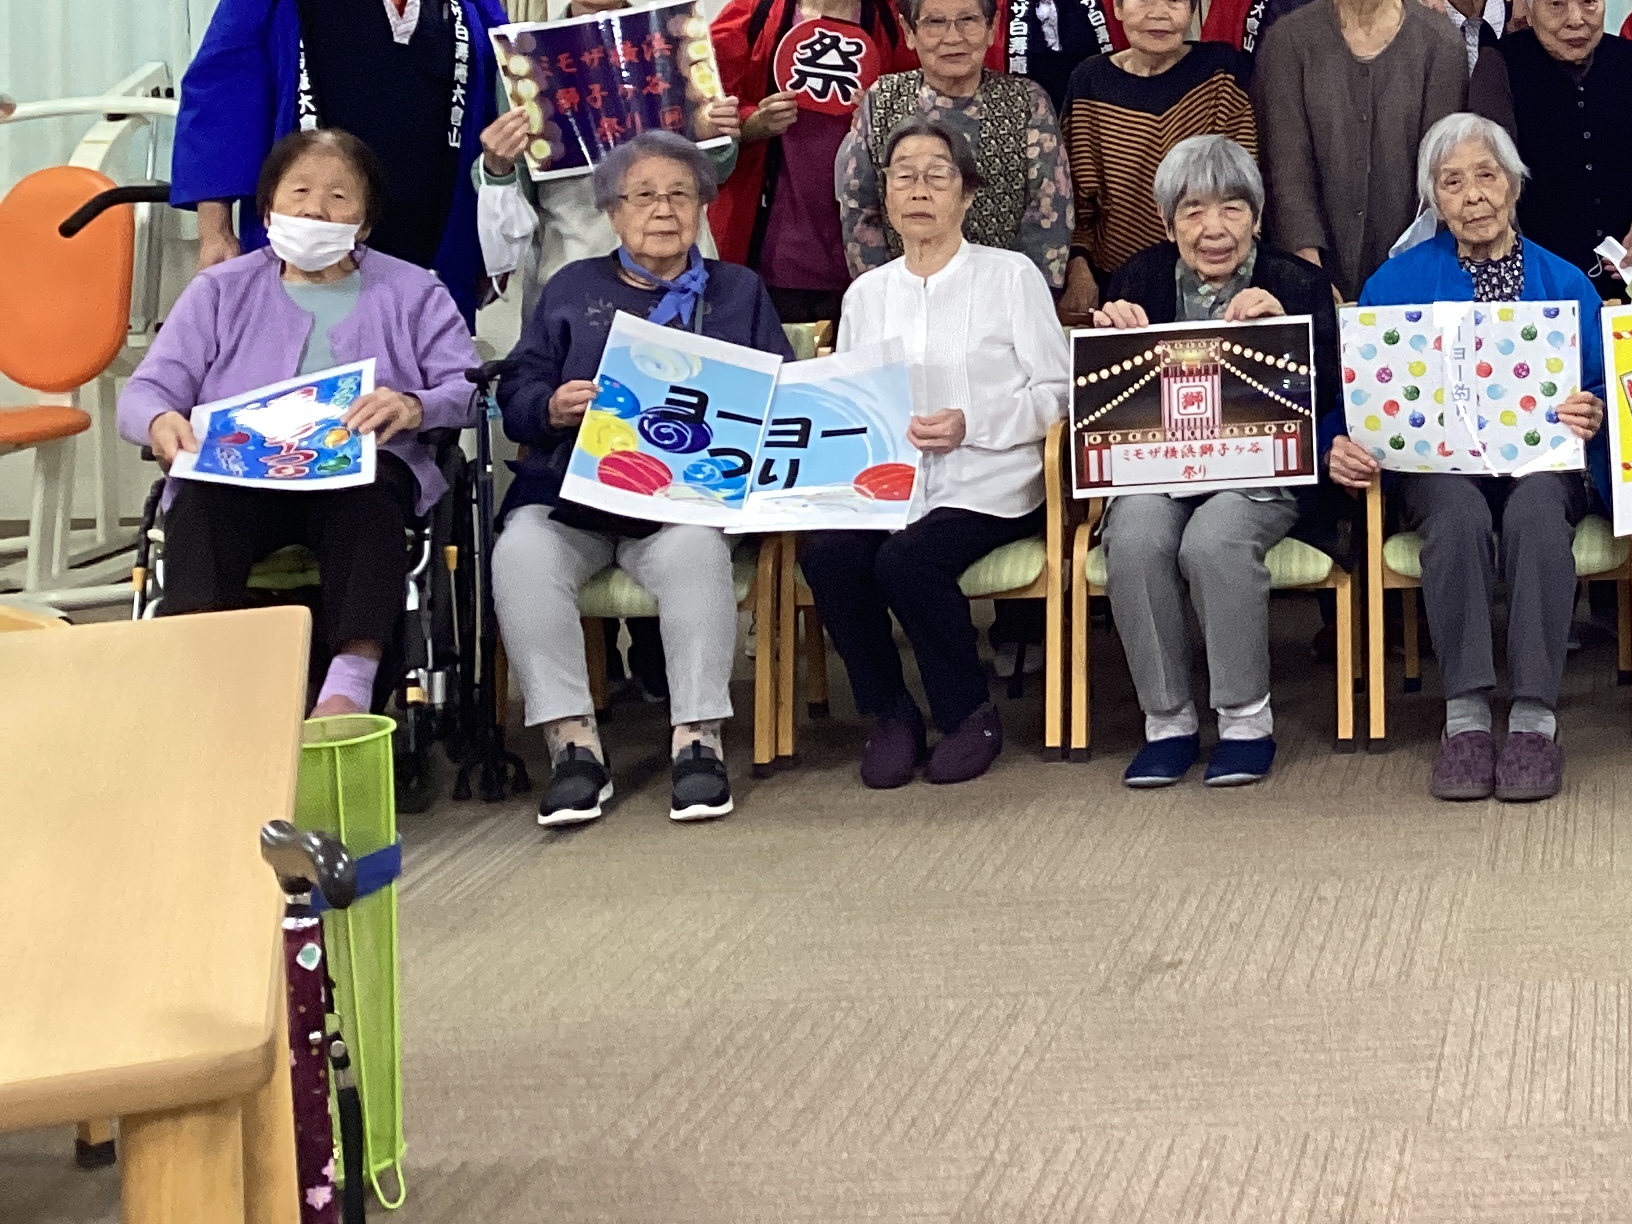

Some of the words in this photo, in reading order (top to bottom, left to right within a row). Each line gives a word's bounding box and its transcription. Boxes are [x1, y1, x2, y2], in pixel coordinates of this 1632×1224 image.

[786, 28, 866, 105] 祭
[660, 385, 868, 450] ヨーヨー
[707, 447, 800, 489] つり
[1181, 464, 1208, 480] 祭り
